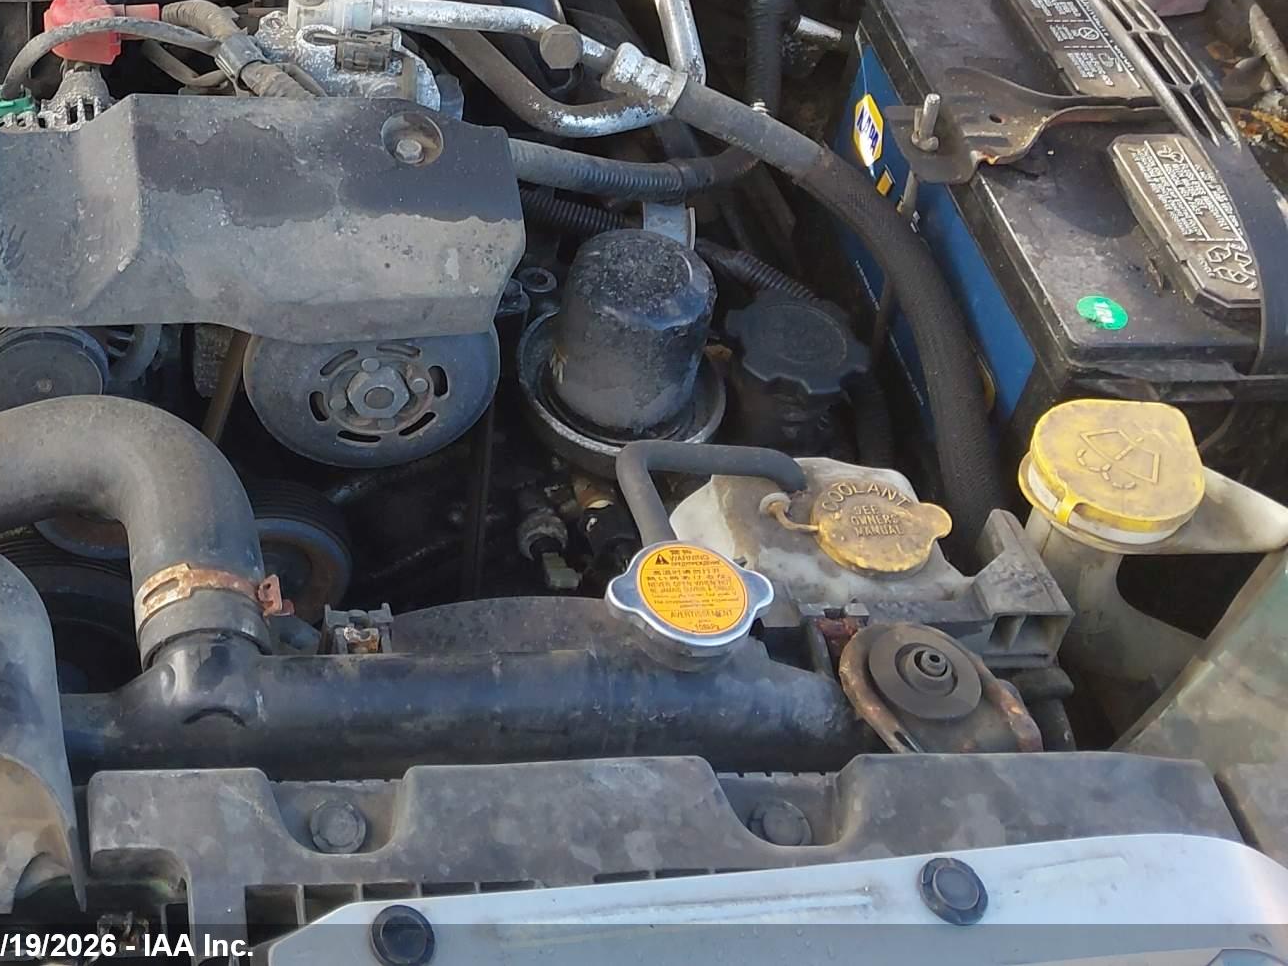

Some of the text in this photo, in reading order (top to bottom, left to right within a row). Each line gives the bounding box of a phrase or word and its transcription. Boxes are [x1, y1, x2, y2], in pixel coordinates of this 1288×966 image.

[822, 481, 912, 512] COOLANT
[853, 505, 879, 514] SEE
[854, 524, 904, 538] MANUAL
